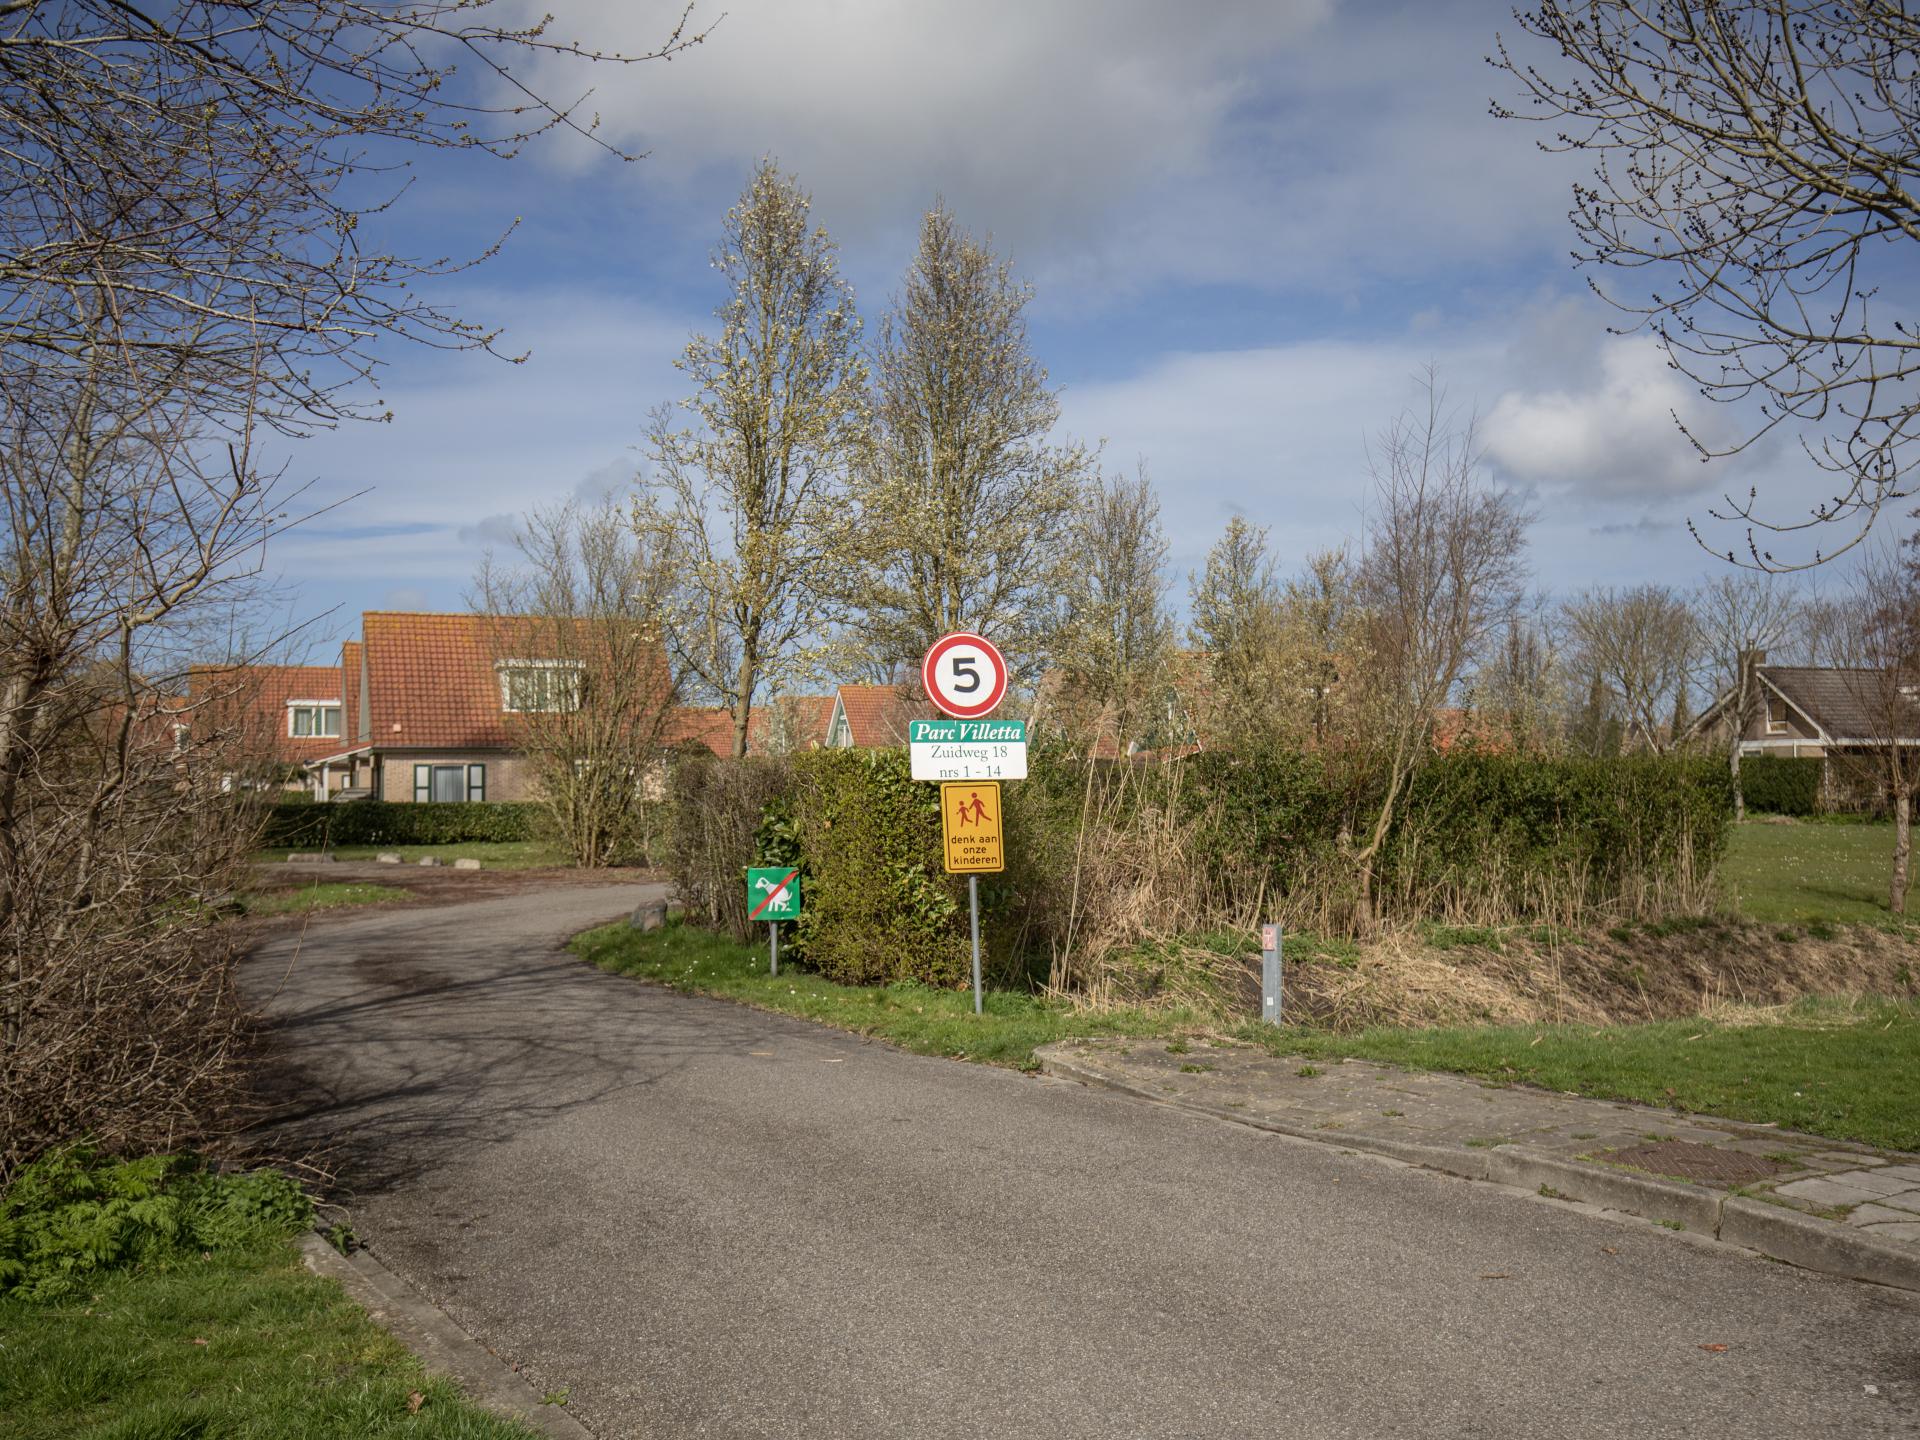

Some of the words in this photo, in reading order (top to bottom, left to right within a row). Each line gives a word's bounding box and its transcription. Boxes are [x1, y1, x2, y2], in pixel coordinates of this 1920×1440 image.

[953, 657, 980, 693] 5
[916, 723, 955, 740] Parc
[960, 723, 1021, 740] Villetta
[931, 745, 988, 762] Zuidweg
[993, 745, 1008, 758] 18
[939, 768, 959, 778] nrs
[963, 765, 971, 777] 1
[986, 765, 1002, 777] 14
[951, 835, 976, 844] denk
[963, 846, 987, 854] onze
[953, 856, 998, 865] kinderen
